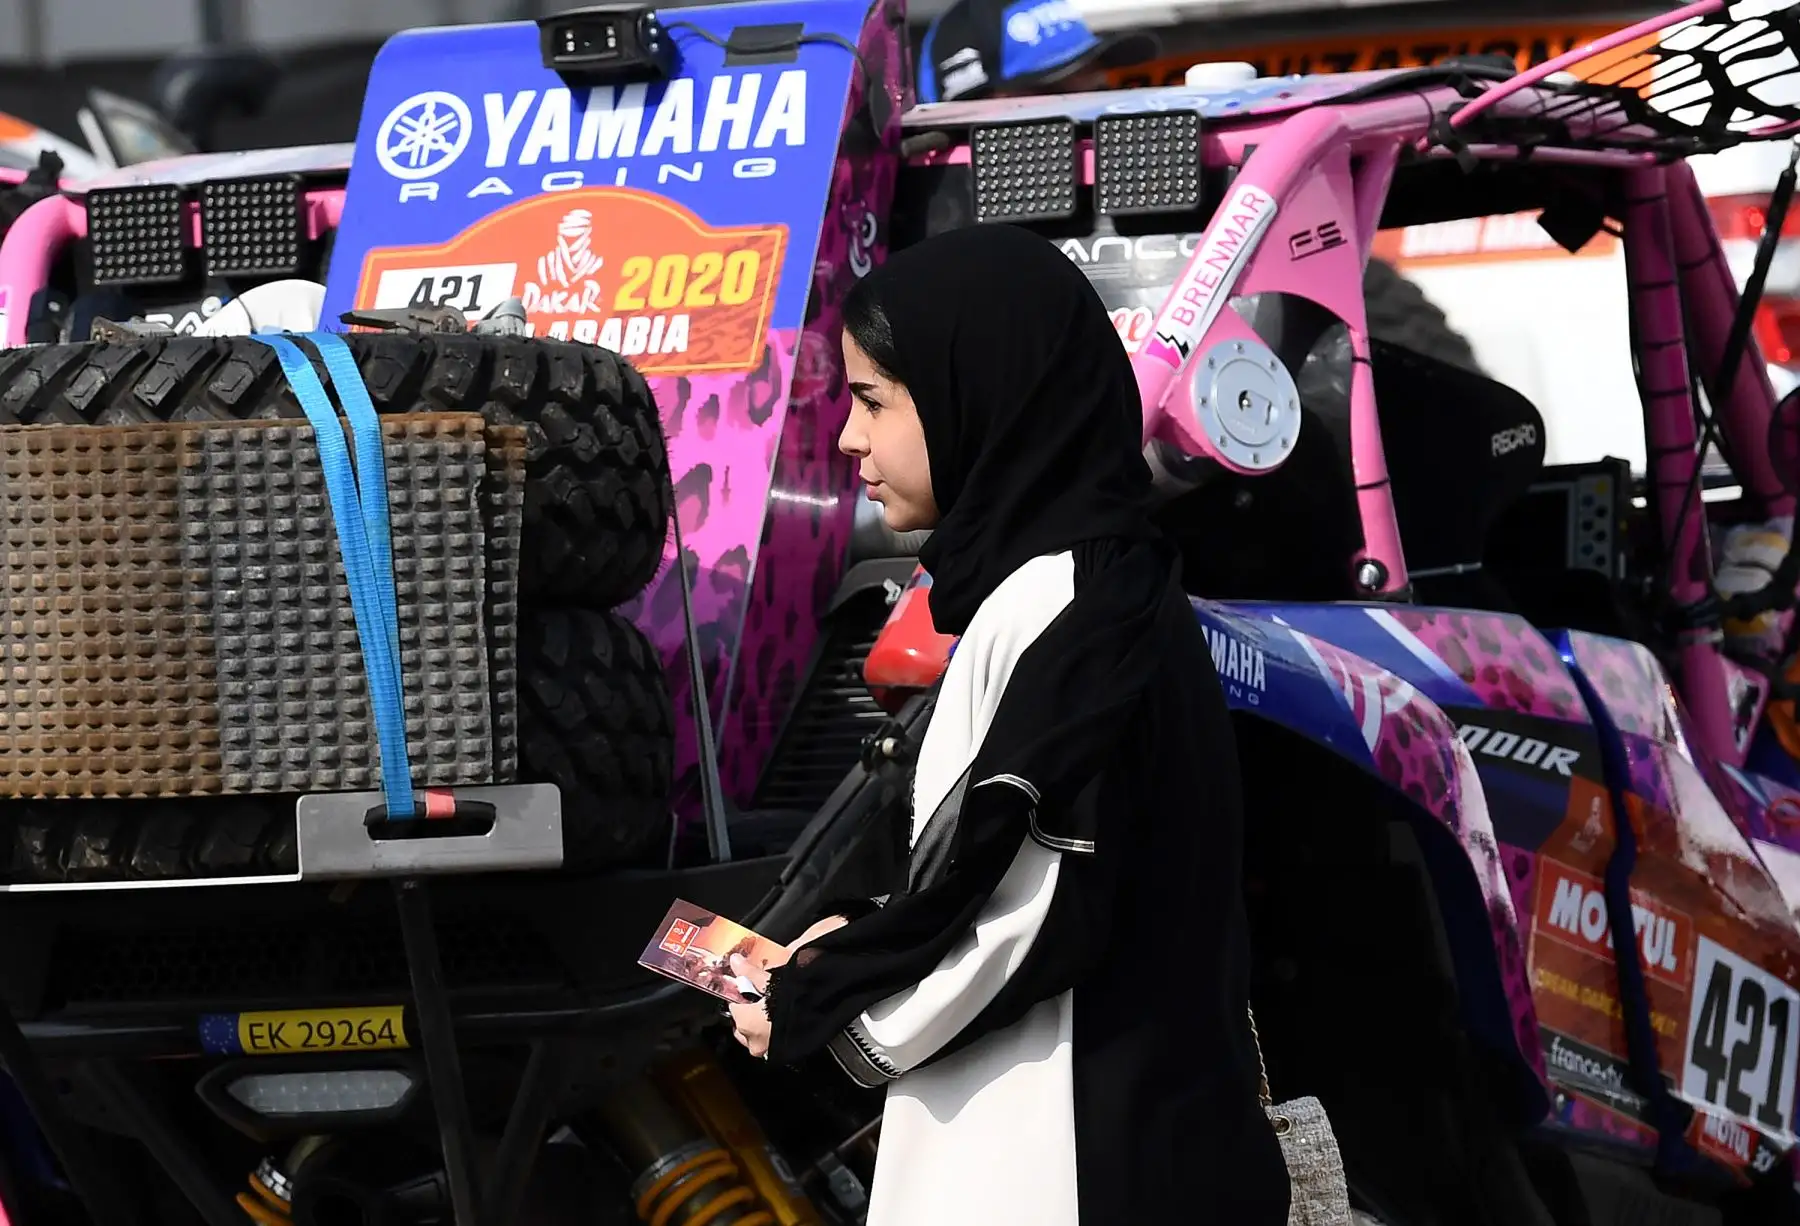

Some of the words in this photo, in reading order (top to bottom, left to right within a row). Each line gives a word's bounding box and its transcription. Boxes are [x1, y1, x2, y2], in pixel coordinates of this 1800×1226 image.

[482, 69, 809, 168] YAMAHA
[399, 158, 777, 203] RACING
[613, 249, 759, 313] 2020
[1171, 191, 1266, 327] BRENMAR
[407, 273, 483, 312] 421
[521, 279, 602, 317] DAKAR
[1200, 624, 1266, 692] MAHA
[248, 1022, 291, 1051] EK
[297, 1018, 398, 1050] 29264
[1691, 959, 1790, 1131] 421
